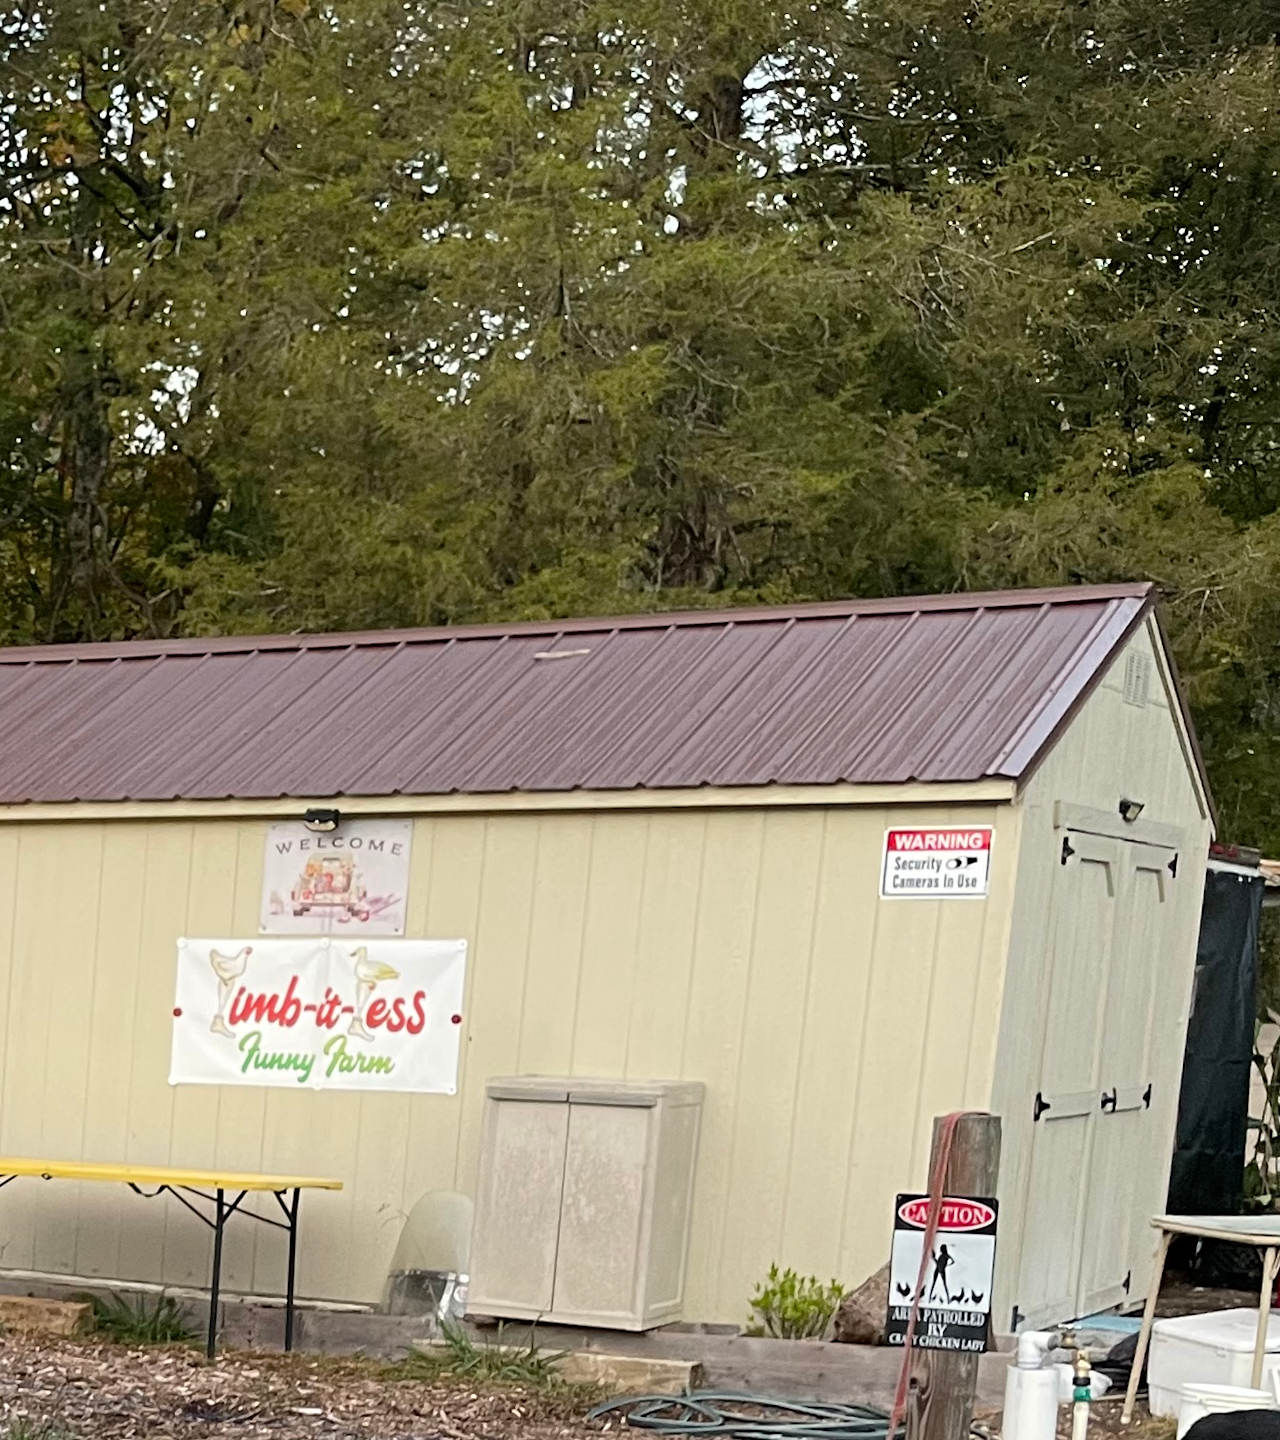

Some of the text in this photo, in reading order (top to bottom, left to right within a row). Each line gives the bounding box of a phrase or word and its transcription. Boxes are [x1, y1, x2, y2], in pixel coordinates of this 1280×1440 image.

[276, 836, 403, 856] WELCOME
[895, 833, 983, 849] WARNING
[894, 856, 942, 873] Security
[893, 874, 977, 888] Cameras In Use
[238, 1031, 396, 1082] Funny Farm
[904, 1205, 986, 1223] CATION
[924, 1310, 985, 1326] PATROLLED
[928, 1324, 947, 1336] BY
[889, 1333, 985, 1351] CRAY CHICKEN LADY
